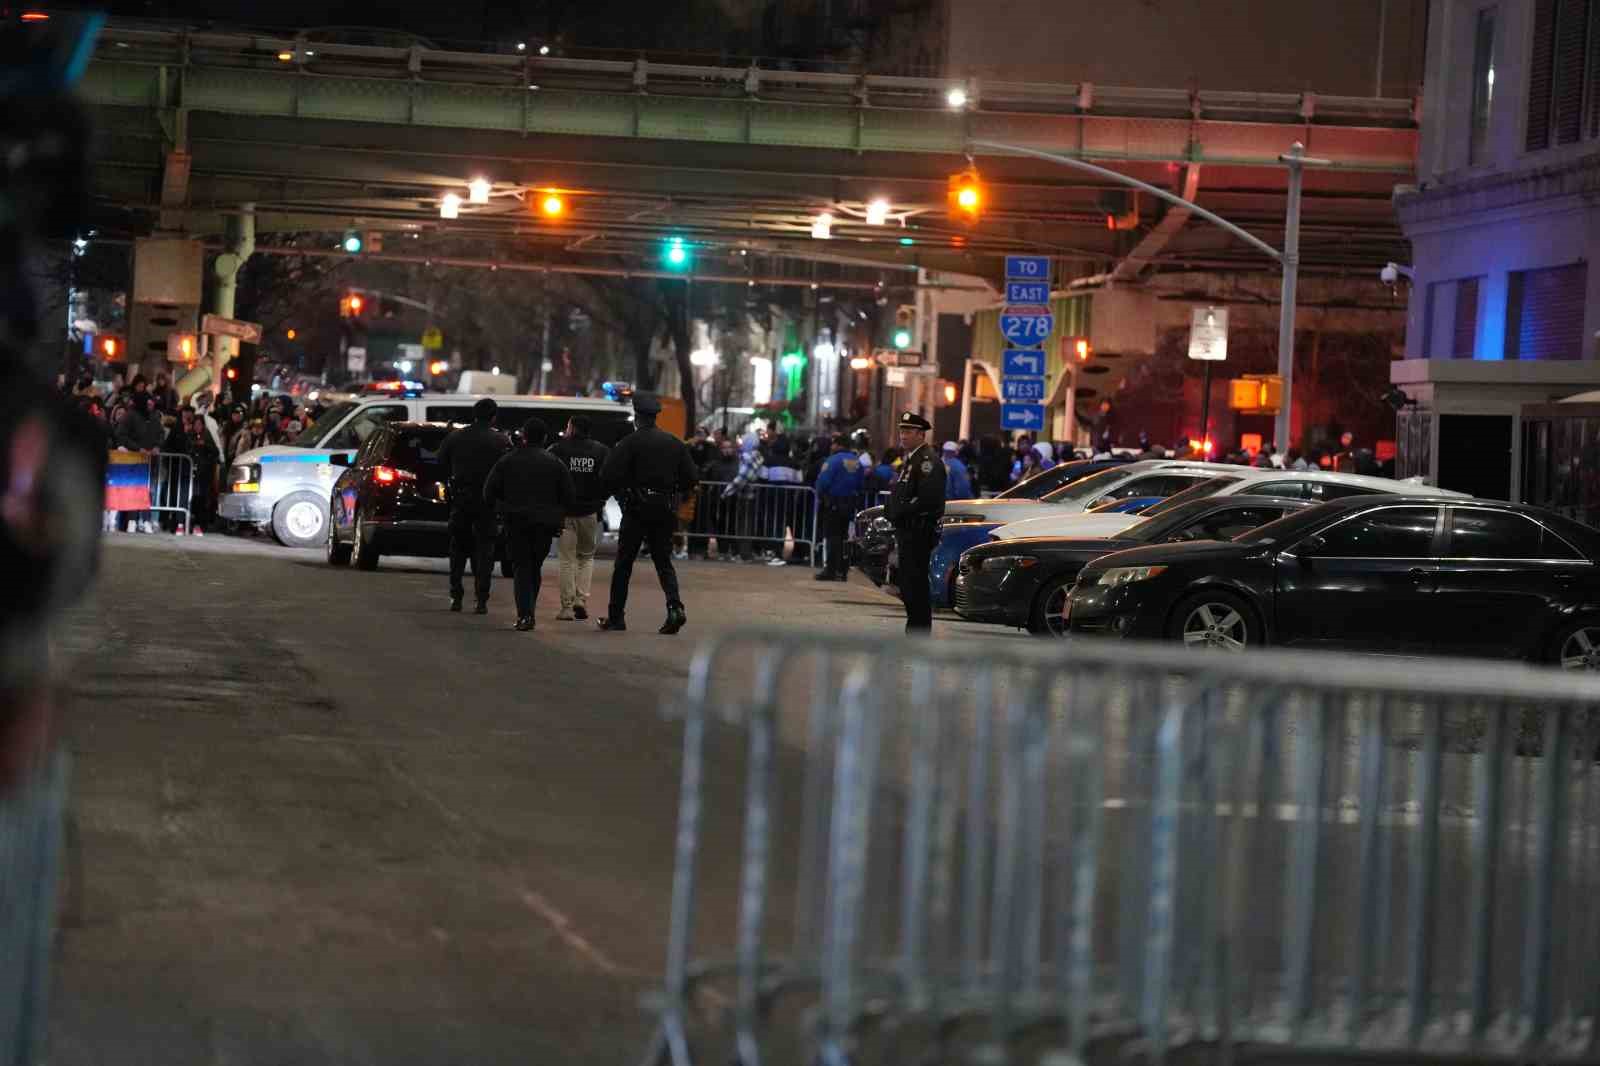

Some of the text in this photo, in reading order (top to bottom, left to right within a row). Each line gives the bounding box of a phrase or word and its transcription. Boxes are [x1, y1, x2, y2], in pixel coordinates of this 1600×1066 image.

[1018, 261, 1038, 274] TO
[1011, 285, 1042, 300] EAST
[1007, 317, 1049, 337] 278
[1007, 382, 1040, 397] WEST
[570, 457, 594, 467] NYPD
